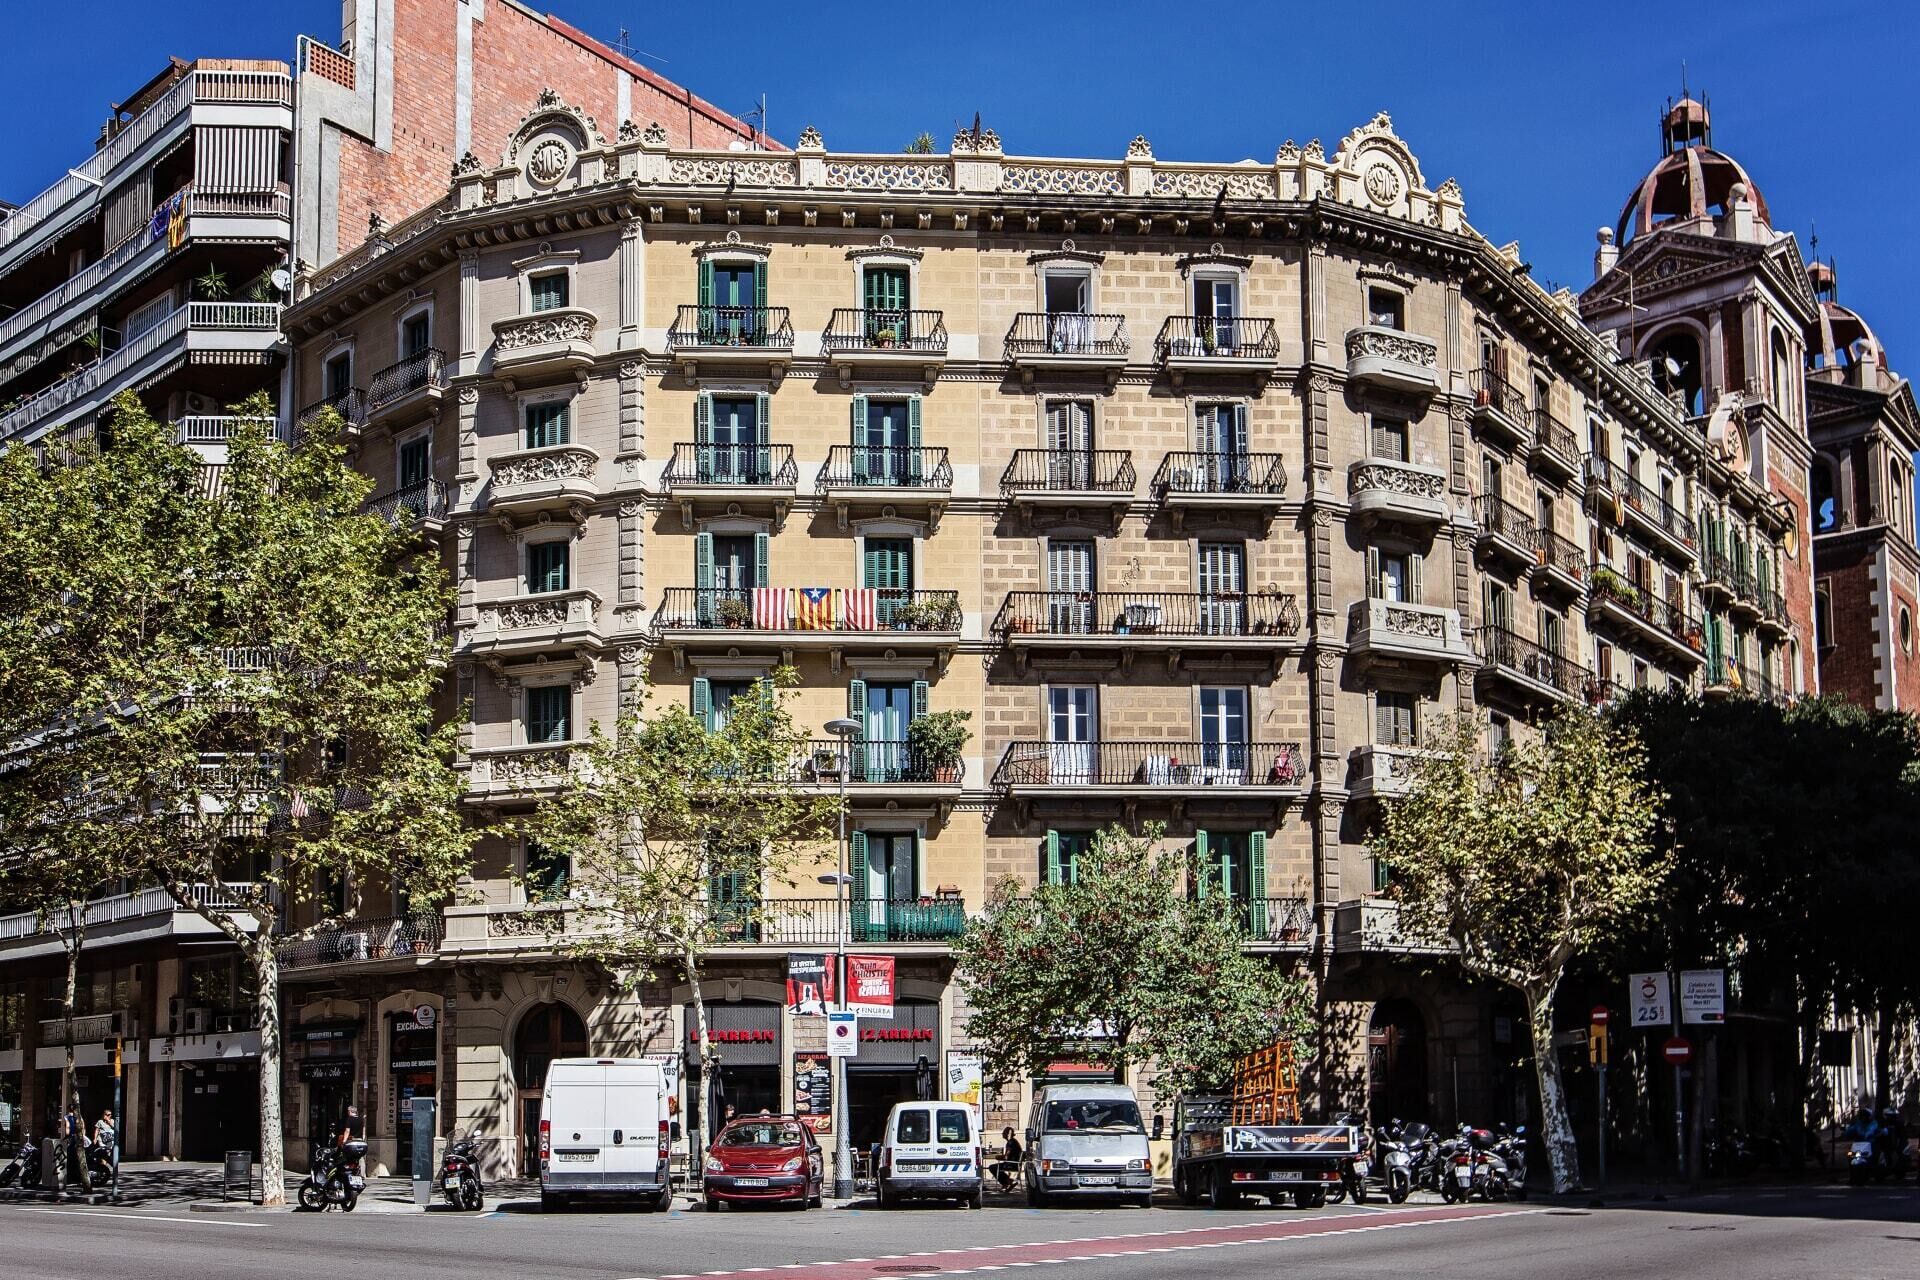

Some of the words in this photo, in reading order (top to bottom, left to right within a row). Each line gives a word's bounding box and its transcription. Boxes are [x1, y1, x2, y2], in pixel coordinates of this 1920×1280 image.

[851, 962, 877, 970] AGATHA
[853, 970, 888, 978] CHRISTIE
[859, 985, 891, 997] RAVAL
[1639, 1006, 1658, 1021] 25
[396, 1022, 434, 1031] EXCHAE
[690, 1029, 775, 1043] LZARRAN
[859, 1027, 933, 1042] IZARRAN
[1259, 1135, 1290, 1143] aluminis
